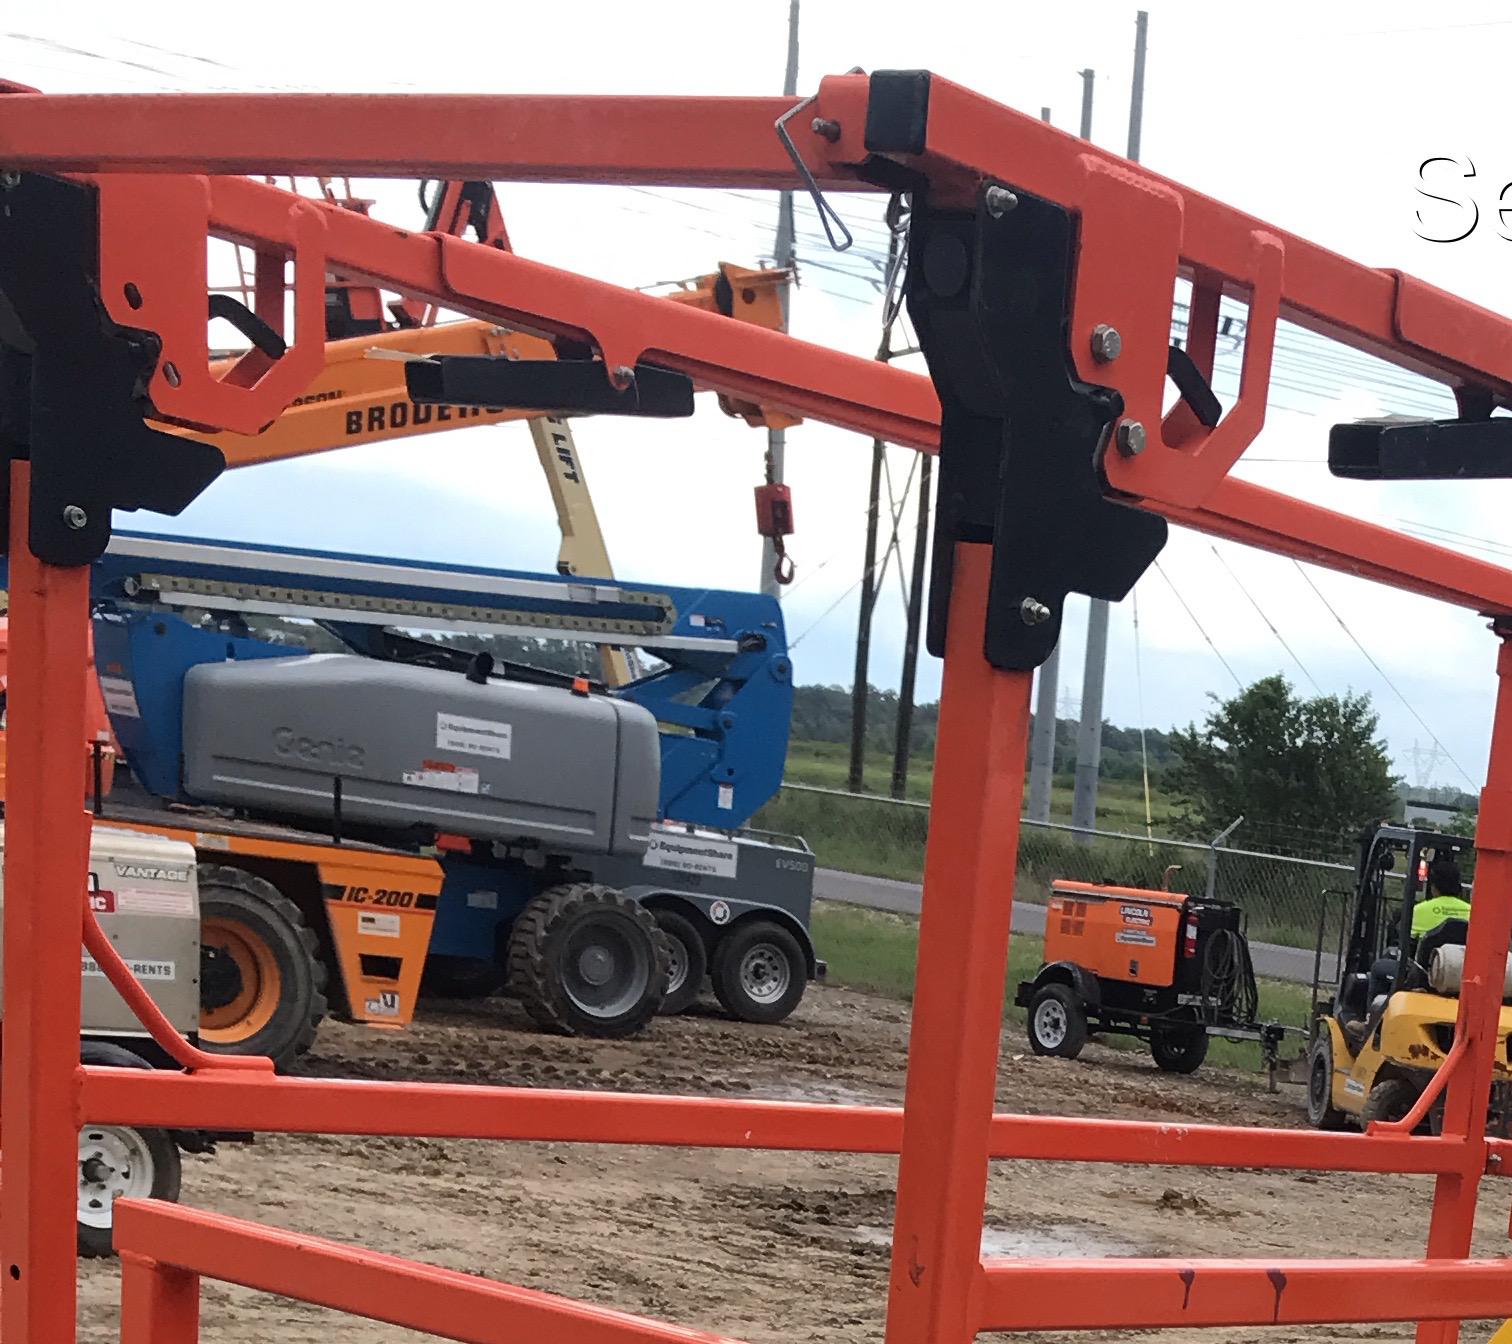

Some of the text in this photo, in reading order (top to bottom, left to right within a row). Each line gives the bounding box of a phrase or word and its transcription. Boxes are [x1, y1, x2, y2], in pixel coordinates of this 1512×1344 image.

[272, 725, 367, 770] Genie
[116, 865, 189, 882] VANTAGE
[345, 886, 413, 908] IC-200
